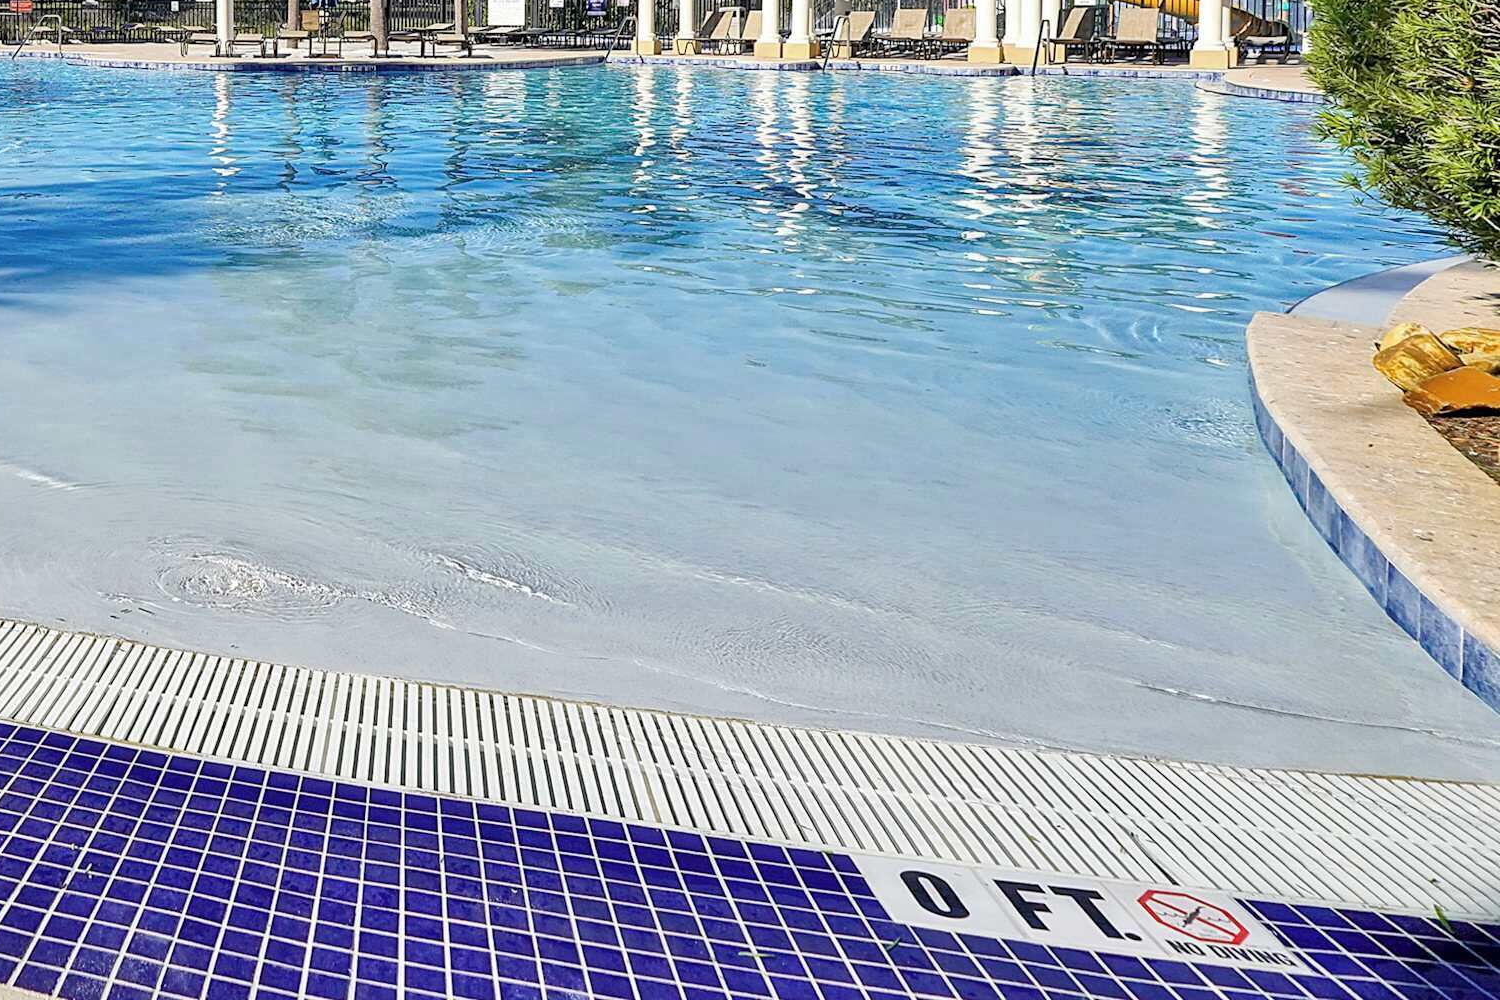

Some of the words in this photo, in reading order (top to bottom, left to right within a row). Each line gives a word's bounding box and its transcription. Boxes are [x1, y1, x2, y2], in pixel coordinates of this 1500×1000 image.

[900, 870, 970, 919] 0
[993, 879, 1142, 942] FT.
[1165, 939, 1206, 956] NO
[1205, 944, 1298, 967] DIVING
